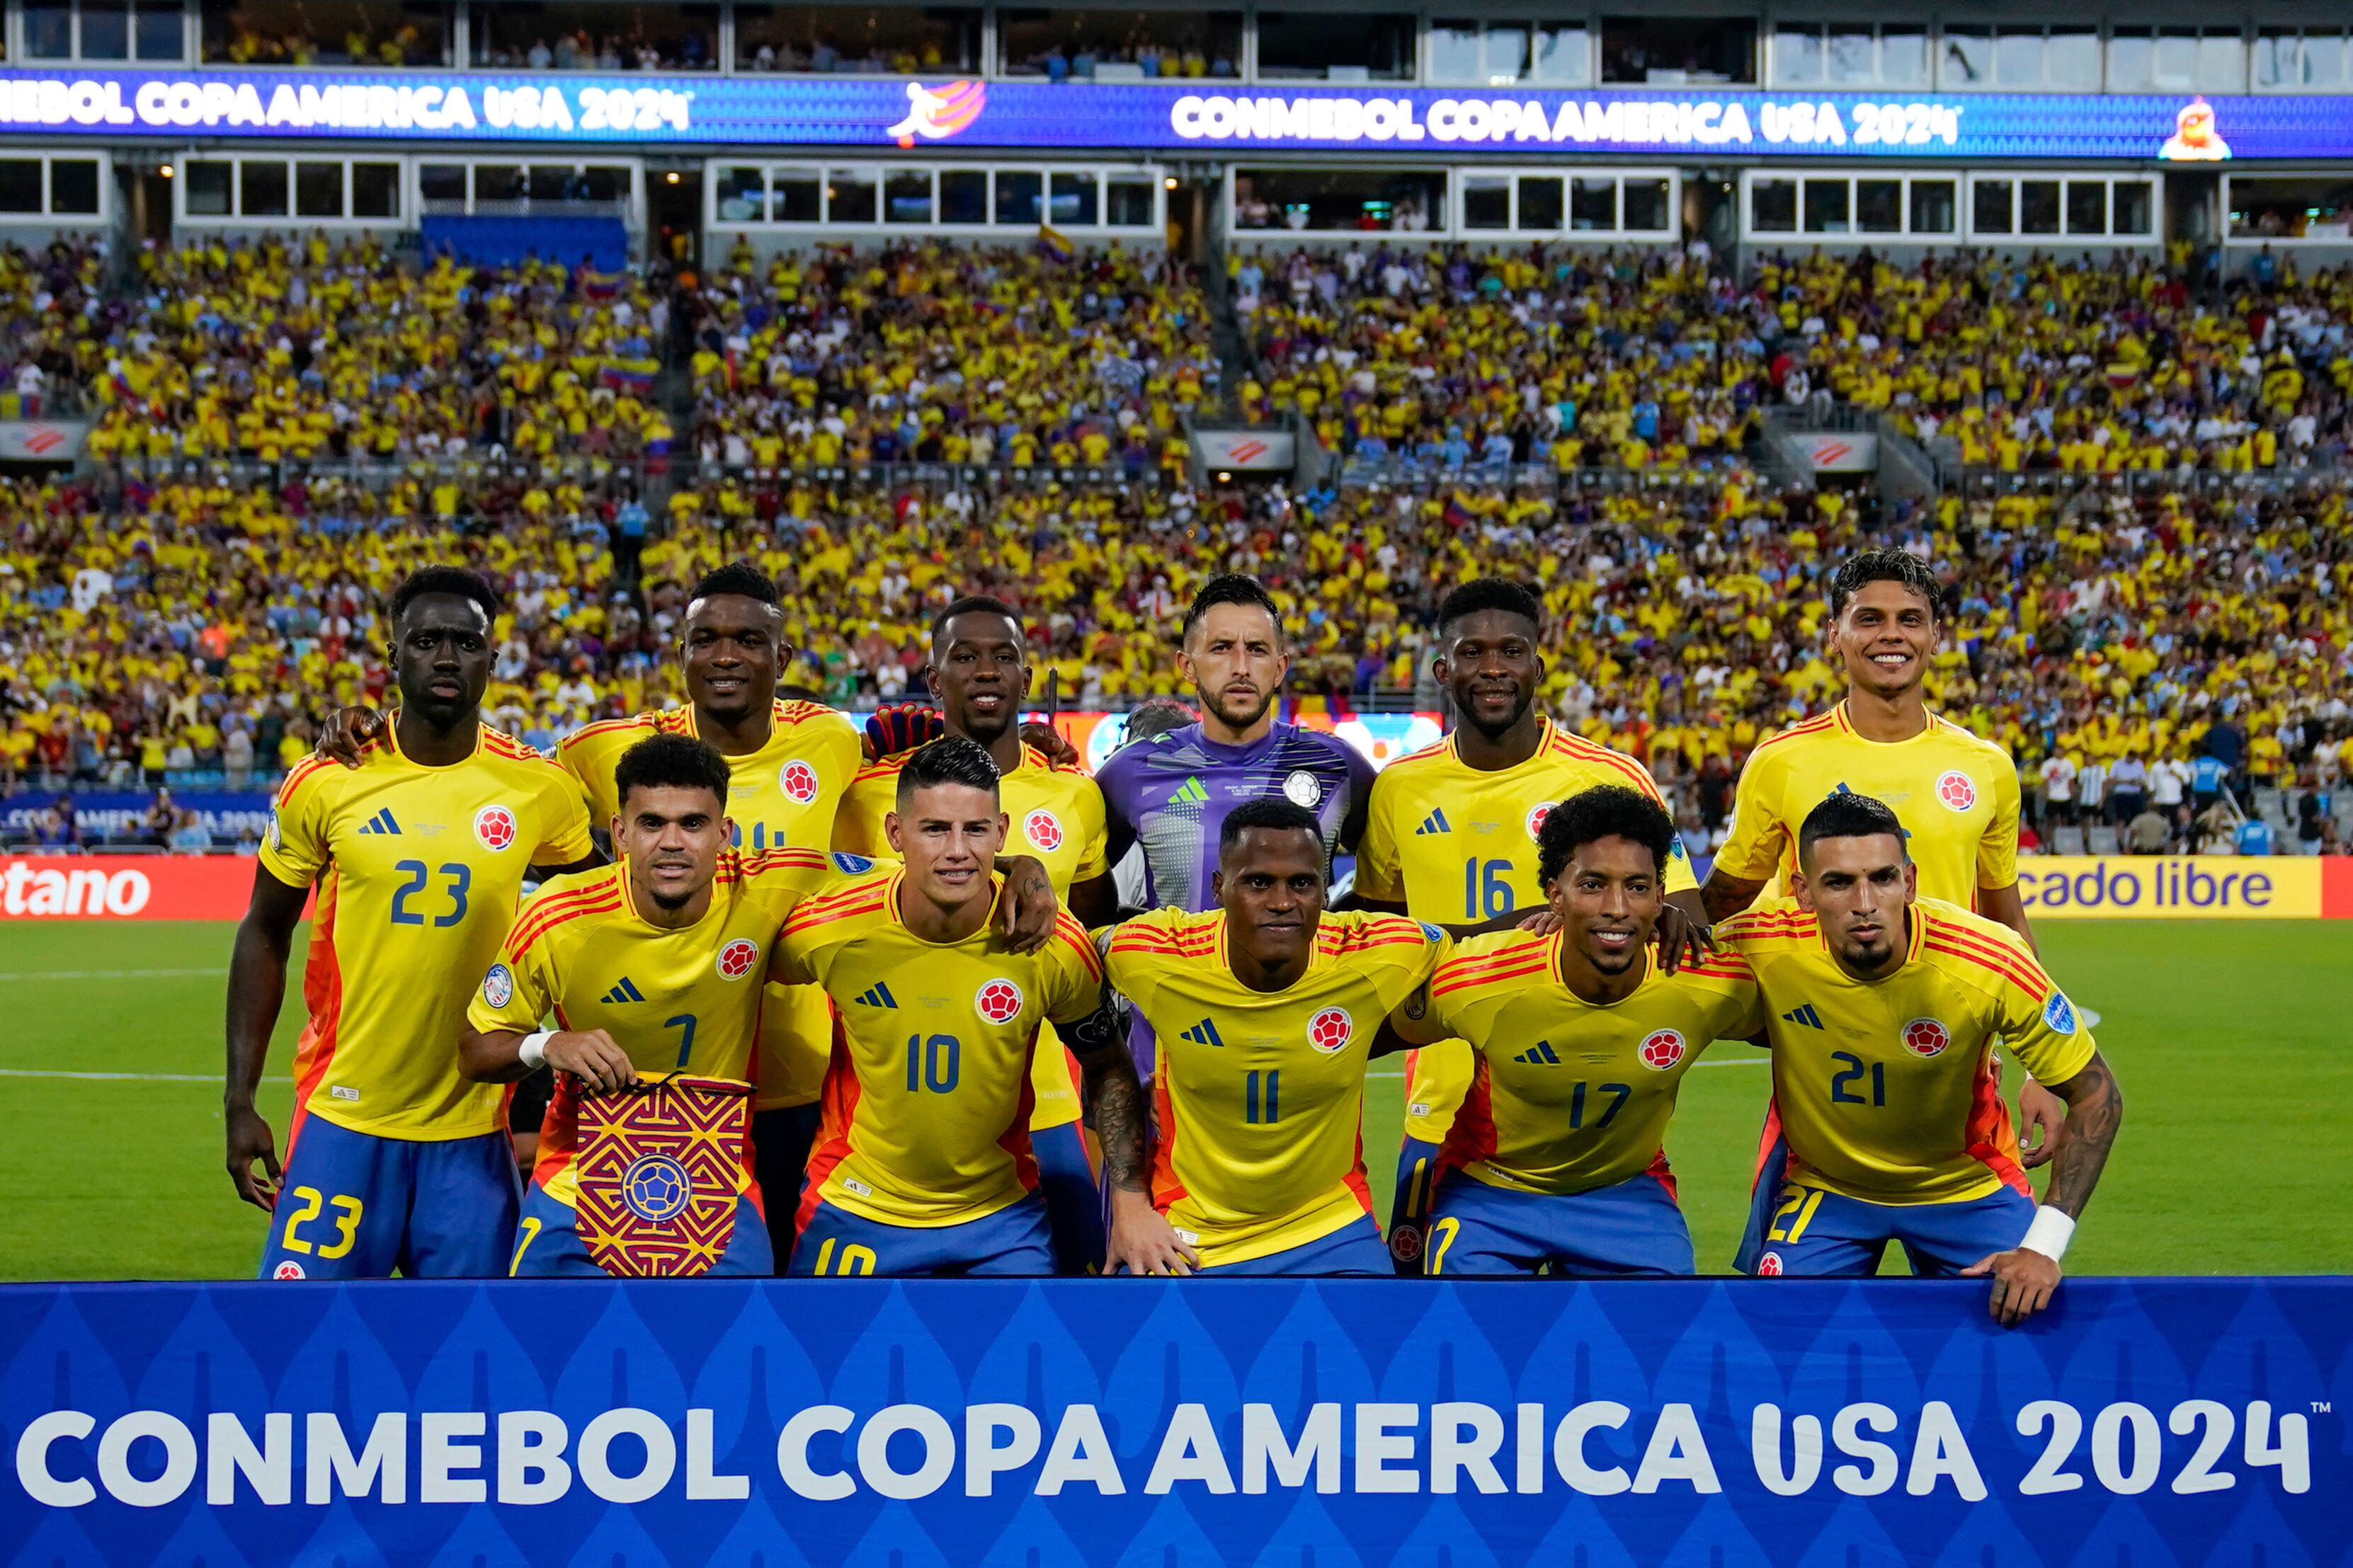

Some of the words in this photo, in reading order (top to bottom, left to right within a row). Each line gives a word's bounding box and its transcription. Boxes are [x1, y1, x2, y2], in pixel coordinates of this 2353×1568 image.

[135, 81, 266, 127] COPA
[266, 84, 477, 130] AMERICA
[484, 86, 574, 131] USA
[579, 88, 688, 131] 2024
[1171, 96, 1425, 141] CONMEBOL
[1427, 98, 1551, 142] COPA
[1551, 101, 1753, 144] AMERICA
[1760, 103, 1847, 146] USA
[1852, 103, 1957, 145] 2024
[0, 862, 151, 916] tano
[391, 859, 471, 927] 23
[1466, 857, 1514, 920] 16
[2155, 862, 2272, 907] libre
[665, 1014, 697, 1068] 7
[907, 1034, 959, 1094] 10
[1246, 1070, 1279, 1123] 11
[1569, 1082, 1631, 1129] 17
[1830, 1051, 1886, 1107] 21
[282, 1185, 363, 1259] 23
[1767, 1184, 1825, 1244] 21
[17, 1409, 748, 1506] CONMEBOL
[777, 1403, 1126, 1501] COPA
[1144, 1402, 1722, 1495] AMERICA
[1752, 1401, 1988, 1501] USA
[2017, 1400, 2311, 1494] 2024
